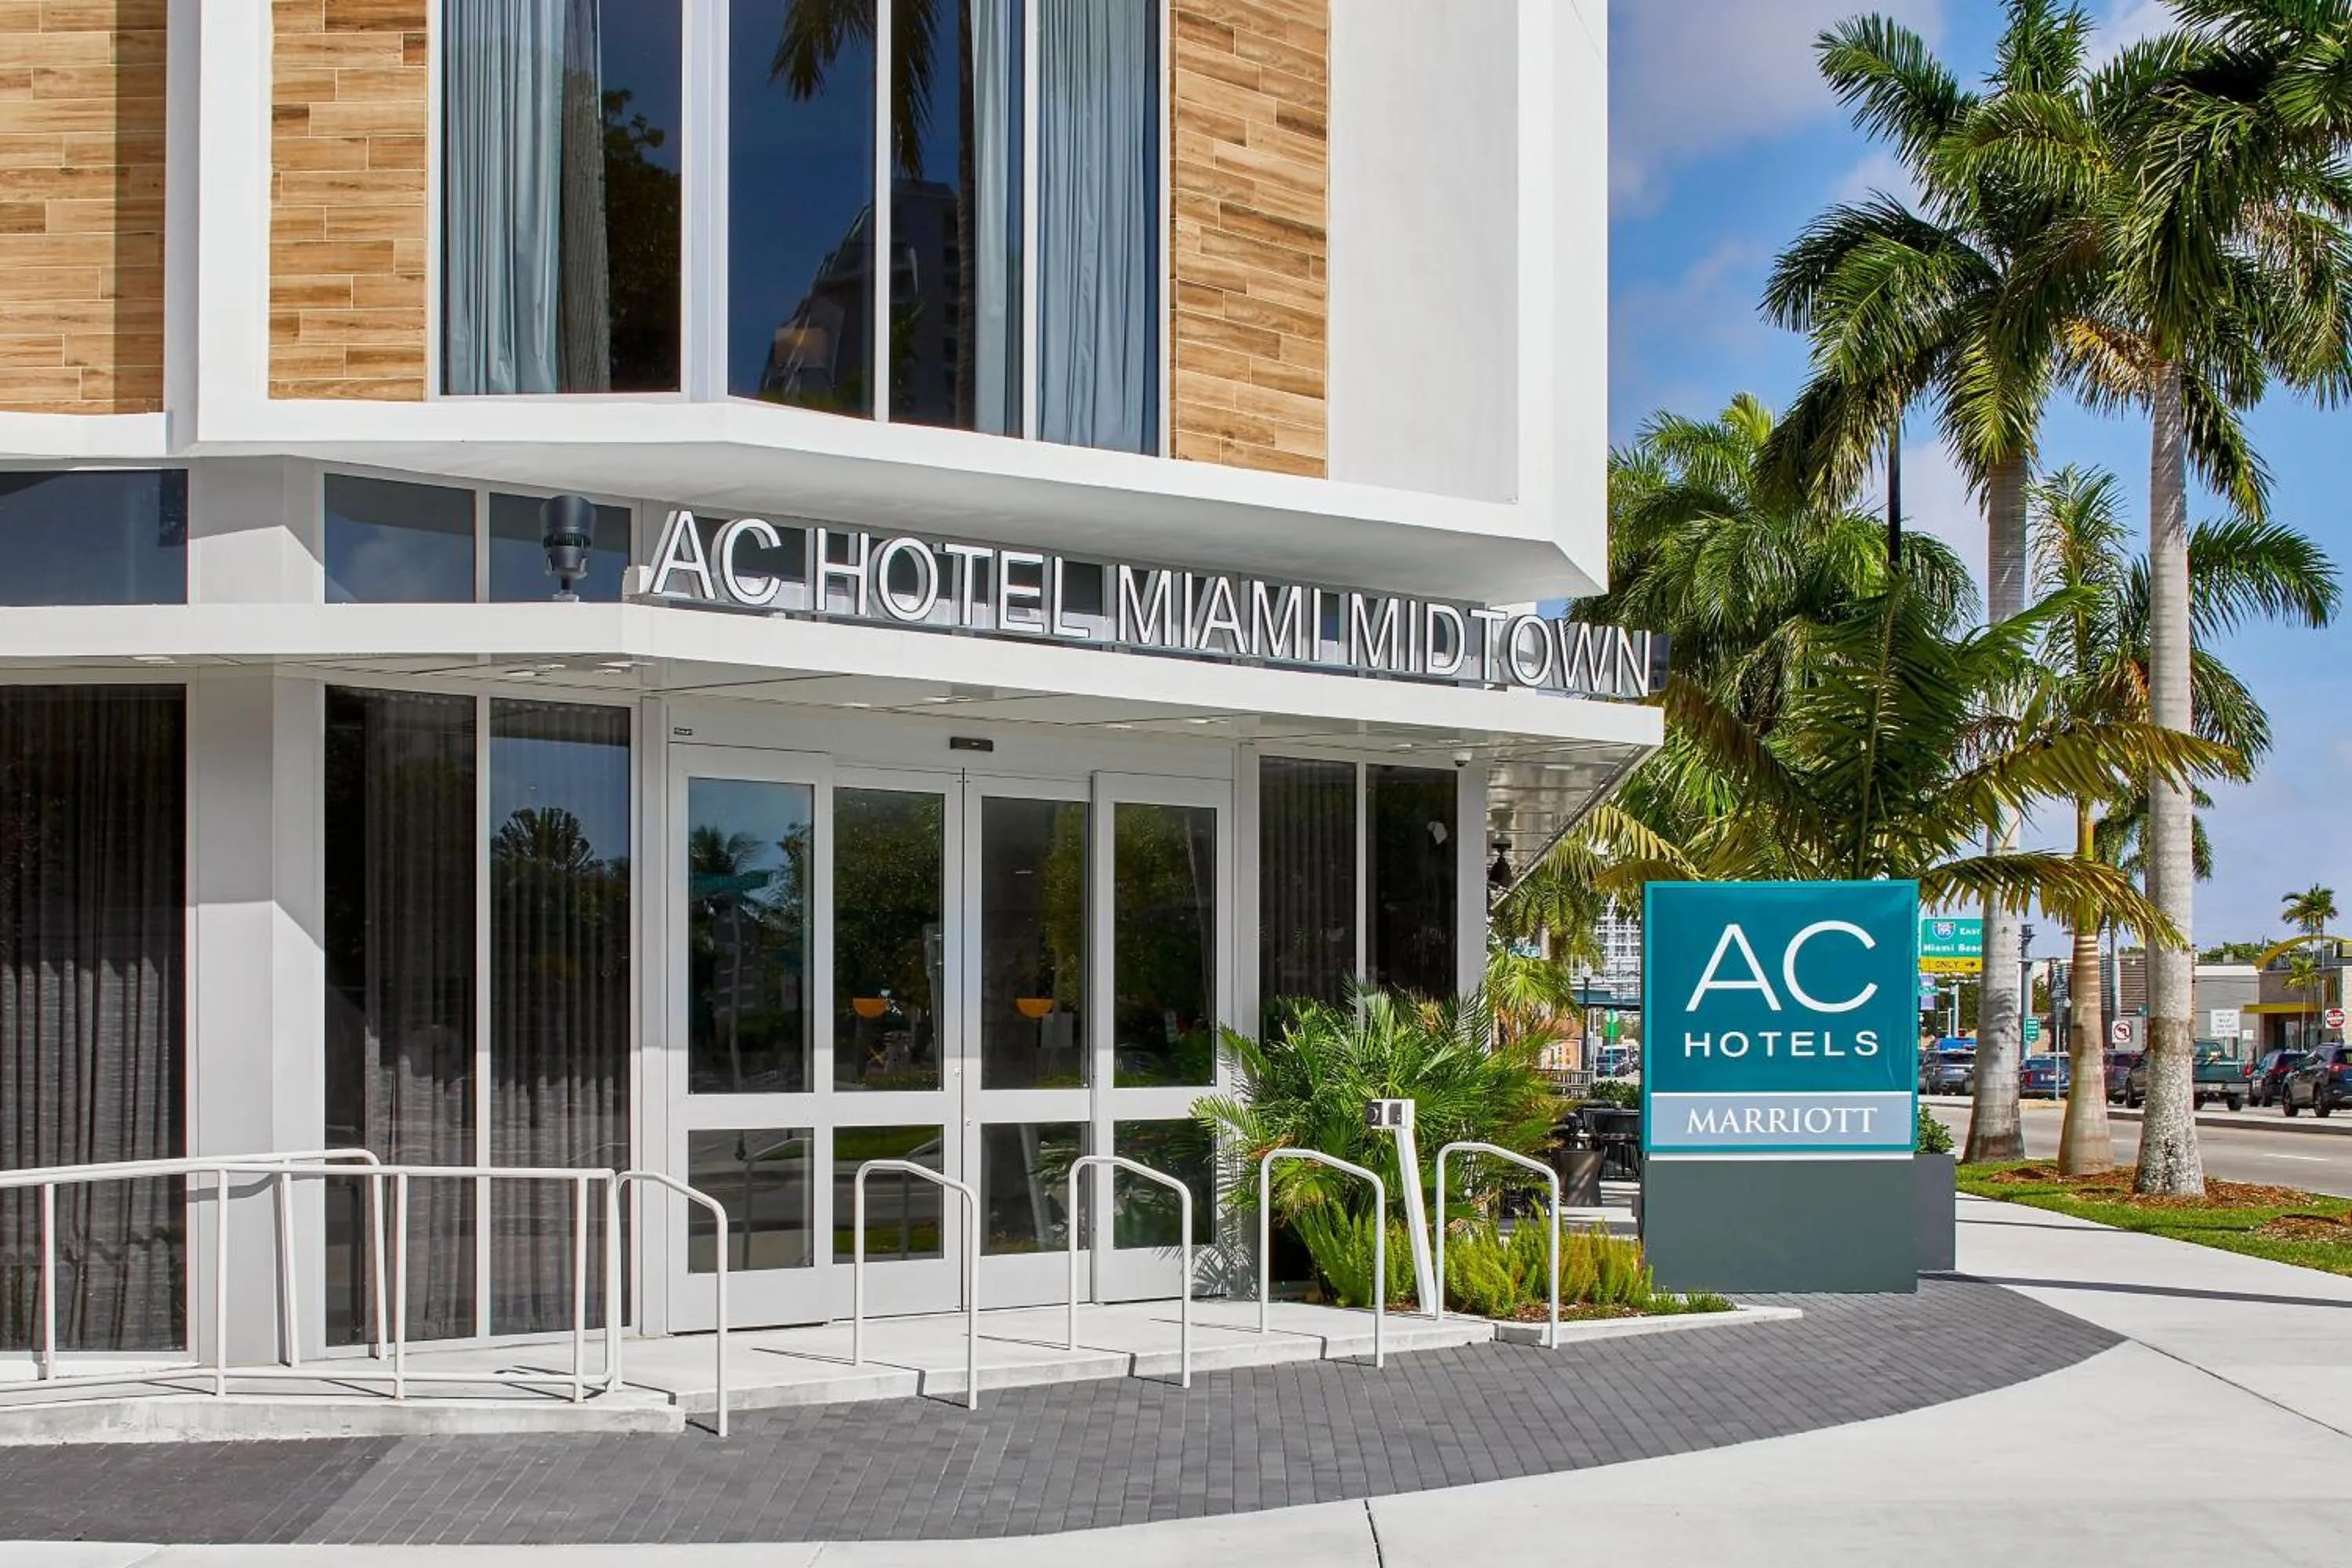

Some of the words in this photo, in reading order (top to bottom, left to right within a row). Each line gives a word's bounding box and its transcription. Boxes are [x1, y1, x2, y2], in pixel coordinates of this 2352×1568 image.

[646, 509, 783, 606] AC
[810, 526, 1091, 639] HOTEL
[1115, 564, 1322, 662] MIAMI
[1347, 592, 1652, 697] MIDTOWN
[1923, 943, 1955, 952] Miami
[1958, 943, 1982, 952] Beac
[1685, 919, 1878, 1014] AC
[1684, 1030, 1879, 1058] HOTELS
[1686, 1107, 1878, 1134] MARRIOTT
